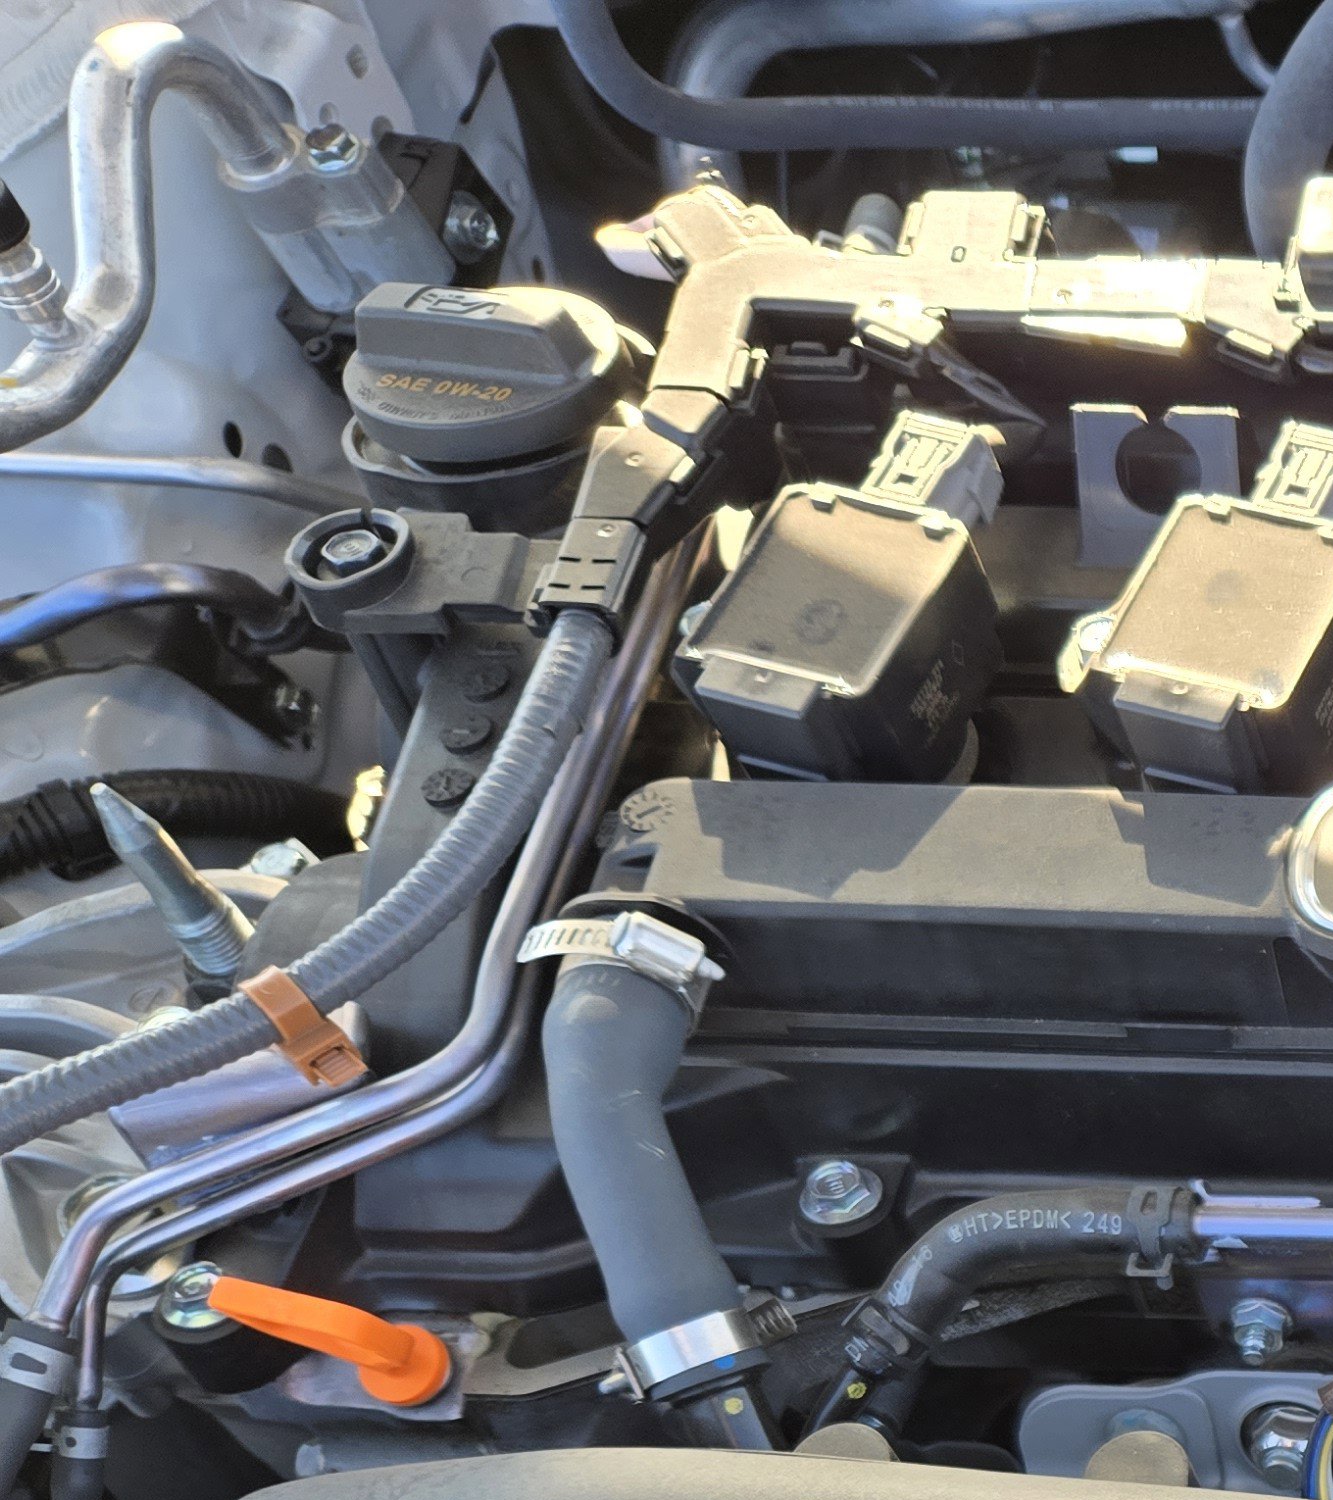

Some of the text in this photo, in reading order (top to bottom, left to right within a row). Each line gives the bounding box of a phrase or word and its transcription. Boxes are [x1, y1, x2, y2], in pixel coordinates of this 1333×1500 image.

[376, 373, 513, 401] SAE 0W-20
[1082, 1211, 1124, 1237] 249
